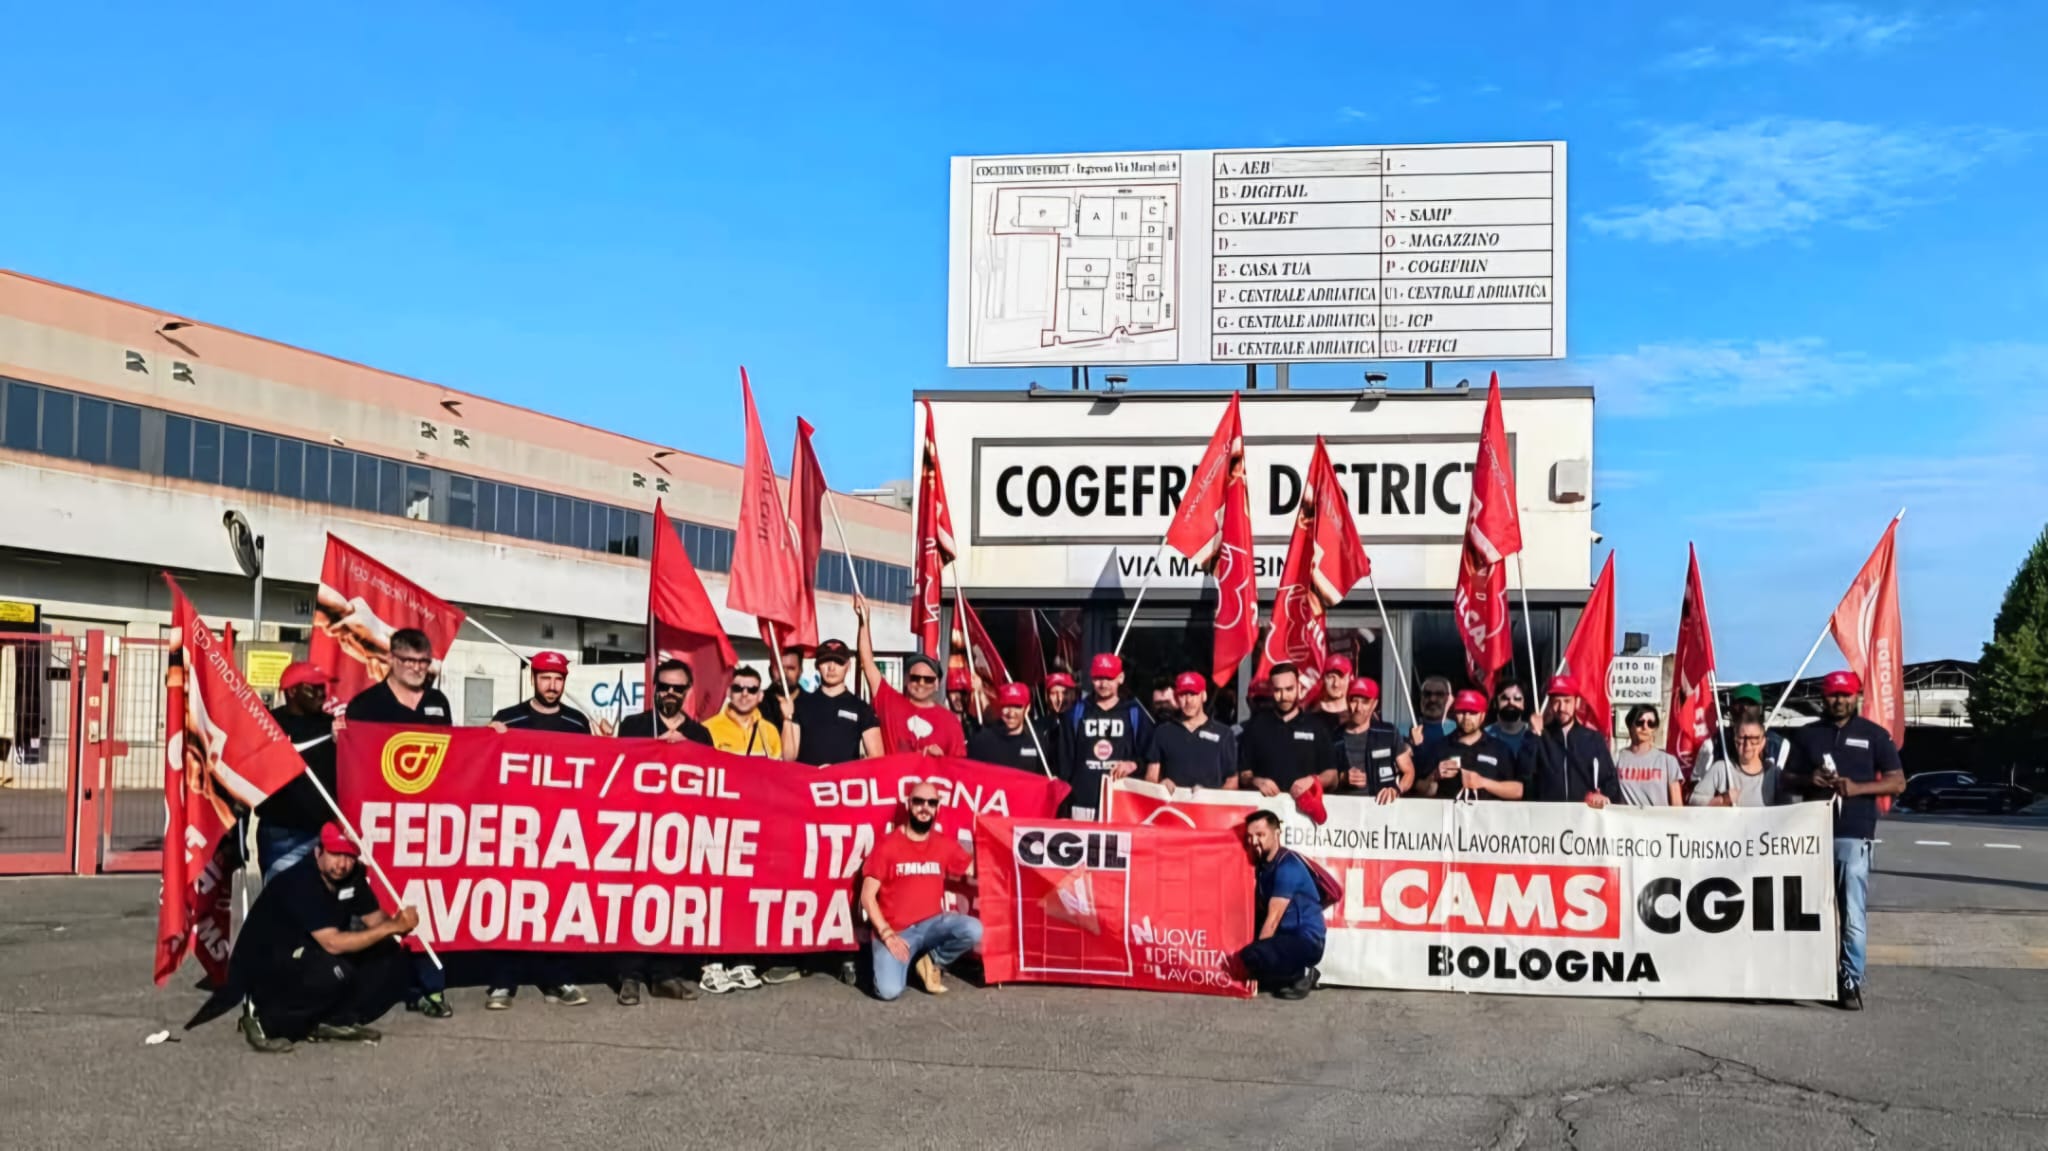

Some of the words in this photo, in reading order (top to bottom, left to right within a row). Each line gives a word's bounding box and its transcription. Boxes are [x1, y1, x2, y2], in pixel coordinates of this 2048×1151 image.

[1115, 162, 1128, 173] Via
[1240, 160, 1271, 175] AEB
[1092, 212, 1100, 221] A
[1241, 211, 1299, 225] VALPET
[1409, 208, 1452, 222] SAMP
[1409, 233, 1500, 248] MAGAZZINO
[1239, 262, 1278, 277] CASA
[1282, 262, 1311, 276] TUA
[1408, 258, 1489, 273] COGEFRIN
[1239, 288, 1305, 303] CENTRALE
[1307, 287, 1376, 302] ADRIATICA
[1407, 285, 1475, 300] CENTRALE
[1477, 283, 1547, 299] ADRIATICA
[1238, 314, 1305, 329] CENTRALE
[1307, 313, 1376, 328] ADRIATICA
[1407, 314, 1433, 328] ICP
[1238, 340, 1305, 355] CENTRALE
[1307, 340, 1375, 354] ADRIATICA
[1408, 339, 1457, 354] UFFICI
[996, 464, 1199, 517] COGEFR
[1269, 462, 1475, 516] DTRIC
[1119, 556, 1160, 577] VIA
[1084, 718, 1125, 737] CFD
[498, 752, 596, 790] FILT
[633, 762, 740, 800] CGIL
[360, 800, 761, 878] FEDERAZIONE
[1284, 825, 1379, 849] EDERAZIONE
[1384, 824, 1454, 852] ITALIANA
[1458, 826, 1555, 855] LAVORATORI
[1560, 829, 1662, 857] COMMERCIO
[1666, 833, 1742, 859] TURISMO
[1746, 839, 1755, 857] E
[1759, 832, 1820, 856] SERVIZI
[1018, 831, 1127, 868] CGIL
[399, 877, 723, 948] AVORATORI
[1637, 875, 1821, 935] CGIL
[1131, 915, 1207, 948] NUOVE
[1428, 945, 1661, 982] BOLOGNA
[1155, 964, 1233, 988] LAVORO
